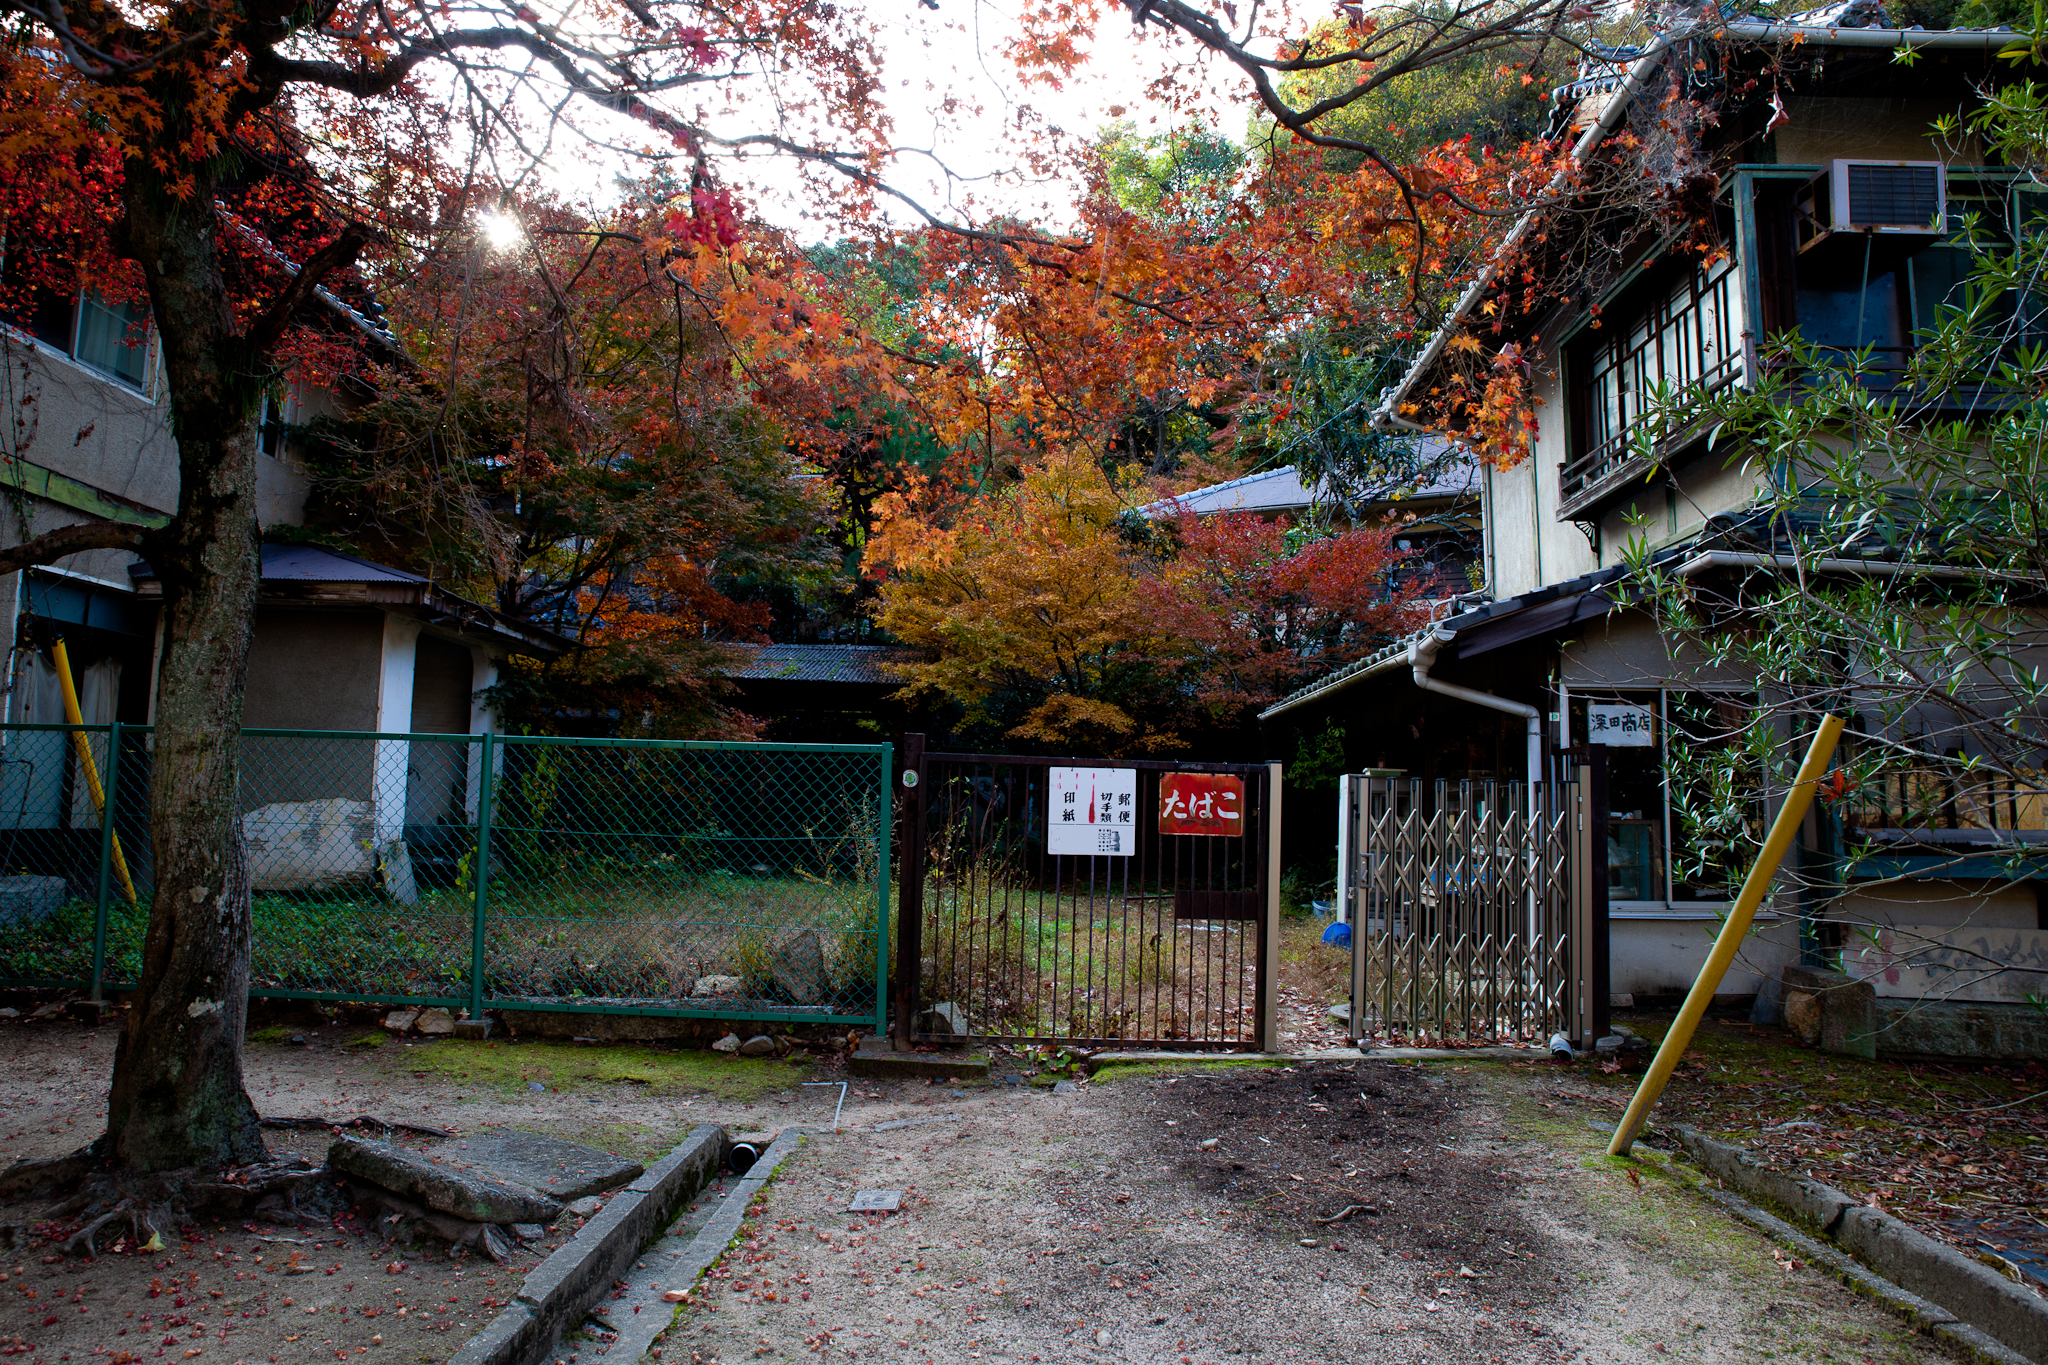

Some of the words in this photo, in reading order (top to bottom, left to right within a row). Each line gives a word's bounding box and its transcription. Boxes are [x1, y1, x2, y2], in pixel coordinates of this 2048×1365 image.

[1590, 711, 1651, 732] 深田商店
[1062, 791, 1075, 822] 印紙
[1100, 792, 1113, 823] 切手類
[1118, 793, 1131, 823] 郵便
[1162, 789, 1240, 820] たばこ
